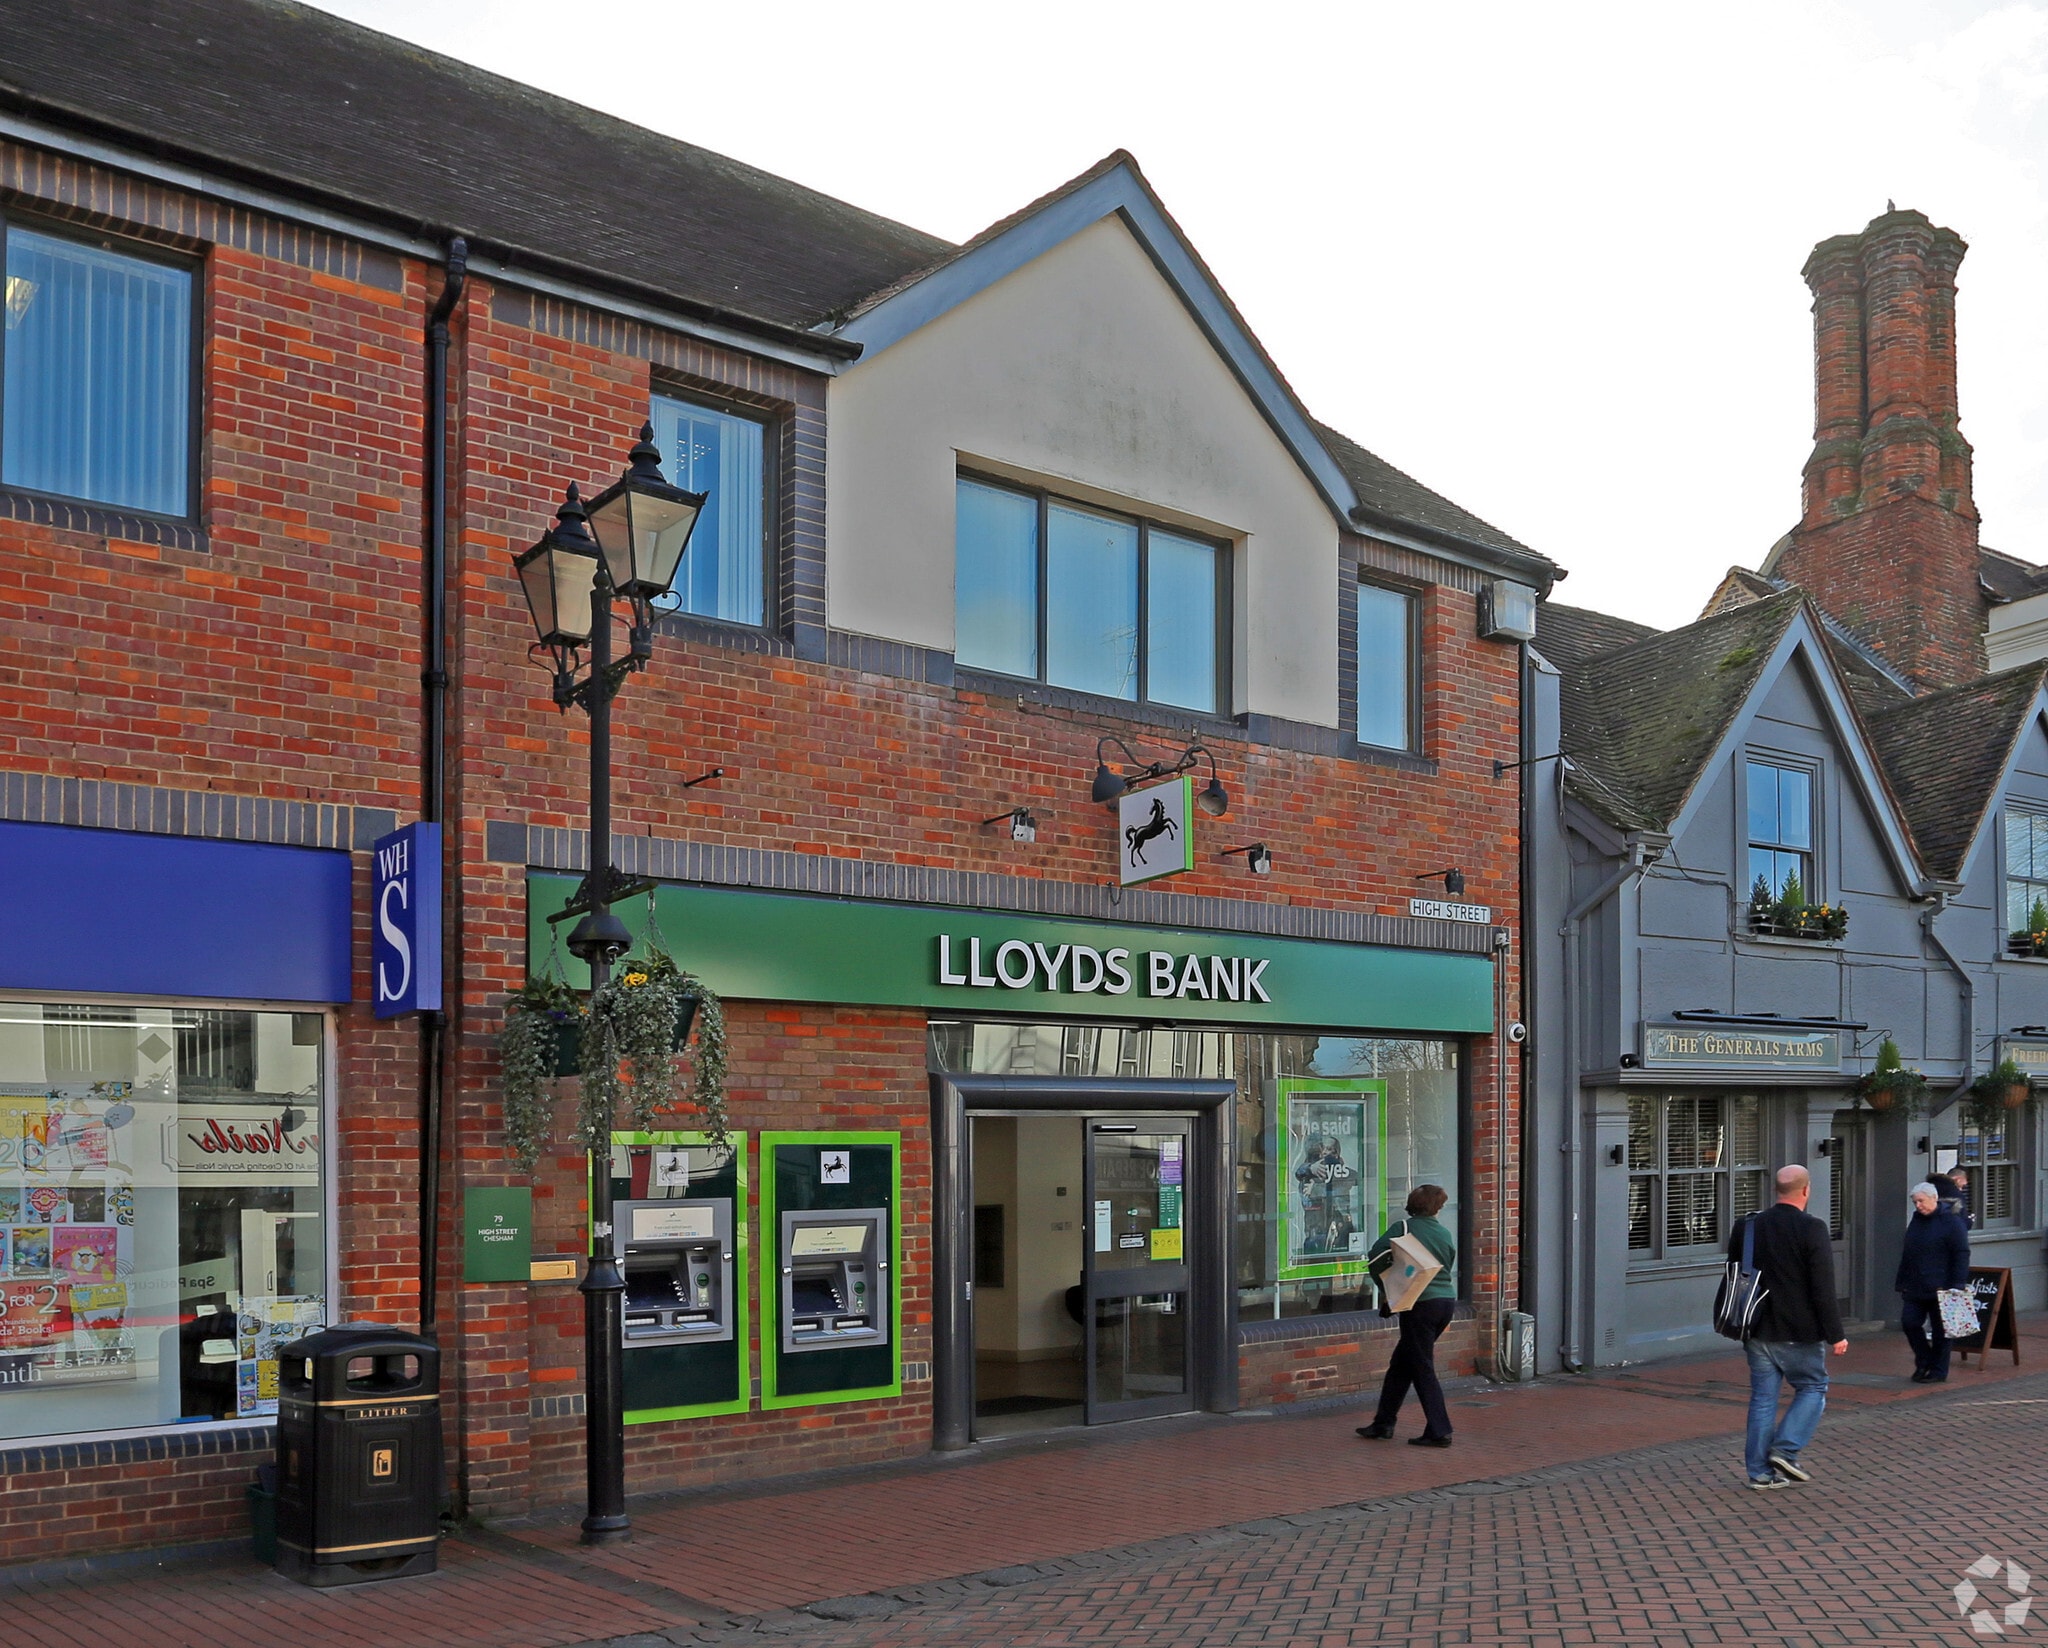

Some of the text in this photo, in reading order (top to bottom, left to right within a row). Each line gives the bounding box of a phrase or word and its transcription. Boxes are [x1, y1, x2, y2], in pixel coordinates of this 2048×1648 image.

[378, 838, 409, 882] WH
[1413, 900, 1488, 922] HIGH STREET
[379, 876, 412, 1002] S
[939, 933, 1272, 1003] LLOYDS BANK
[1666, 1034, 1824, 1058] THE GENERALS ARMS
[2012, 1047, 2048, 1063] FREEH
[1322, 1116, 1351, 1136] said
[1325, 1163, 1350, 1183] yes
[493, 1215, 504, 1223] 79
[10, 1294, 36, 1307] FOR
[36, 1285, 61, 1314] 2
[18, 1323, 55, 1335] Books!
[359, 1407, 408, 1418] LITTER
